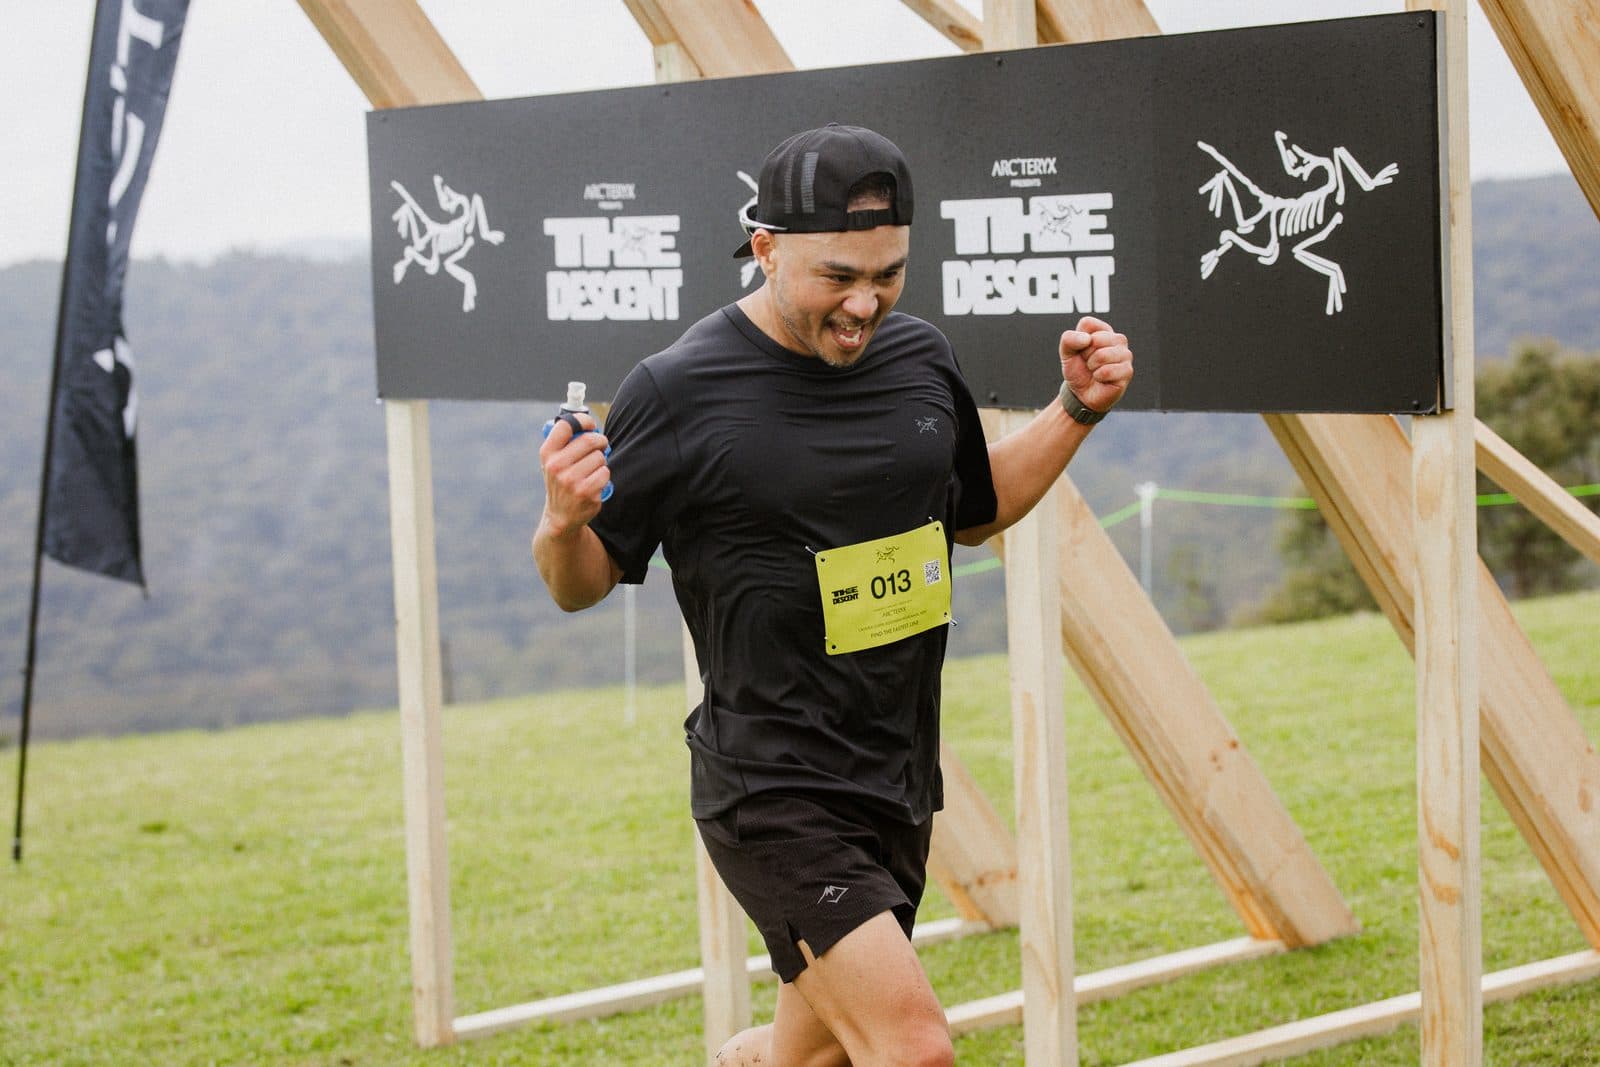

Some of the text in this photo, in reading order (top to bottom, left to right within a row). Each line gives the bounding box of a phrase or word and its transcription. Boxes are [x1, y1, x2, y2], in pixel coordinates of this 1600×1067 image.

[543, 215, 681, 268] THE
[940, 192, 1114, 255] THE
[546, 268, 683, 321] DESCENT
[942, 256, 1115, 315] DESCENT
[831, 585, 859, 598] THE
[832, 593, 859, 605] DESCENT
[870, 569, 911, 600] 013
